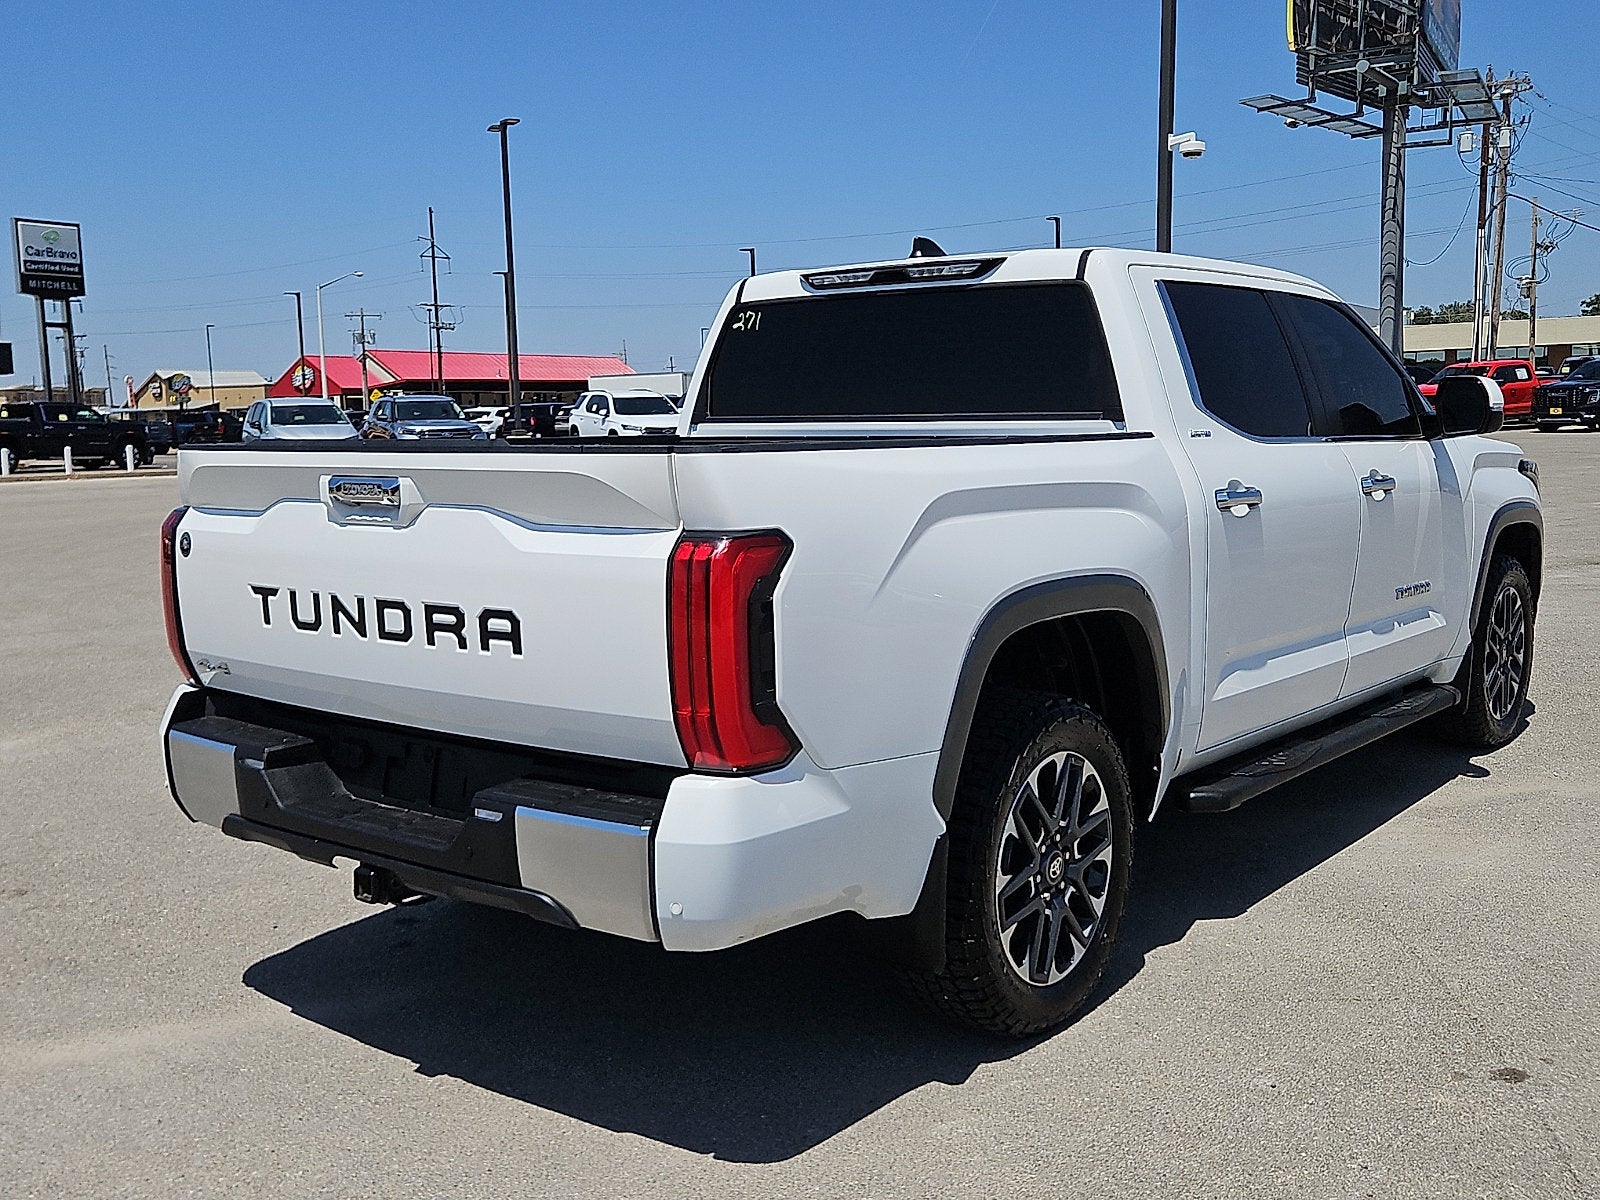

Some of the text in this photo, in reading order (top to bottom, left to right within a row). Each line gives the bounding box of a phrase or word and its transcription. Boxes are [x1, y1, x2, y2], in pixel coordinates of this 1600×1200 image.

[25, 245, 77, 259] CarBravo
[29, 280, 78, 290] MITCHELL
[732, 311, 761, 331] 271
[248, 583, 524, 658] TUNDRA
